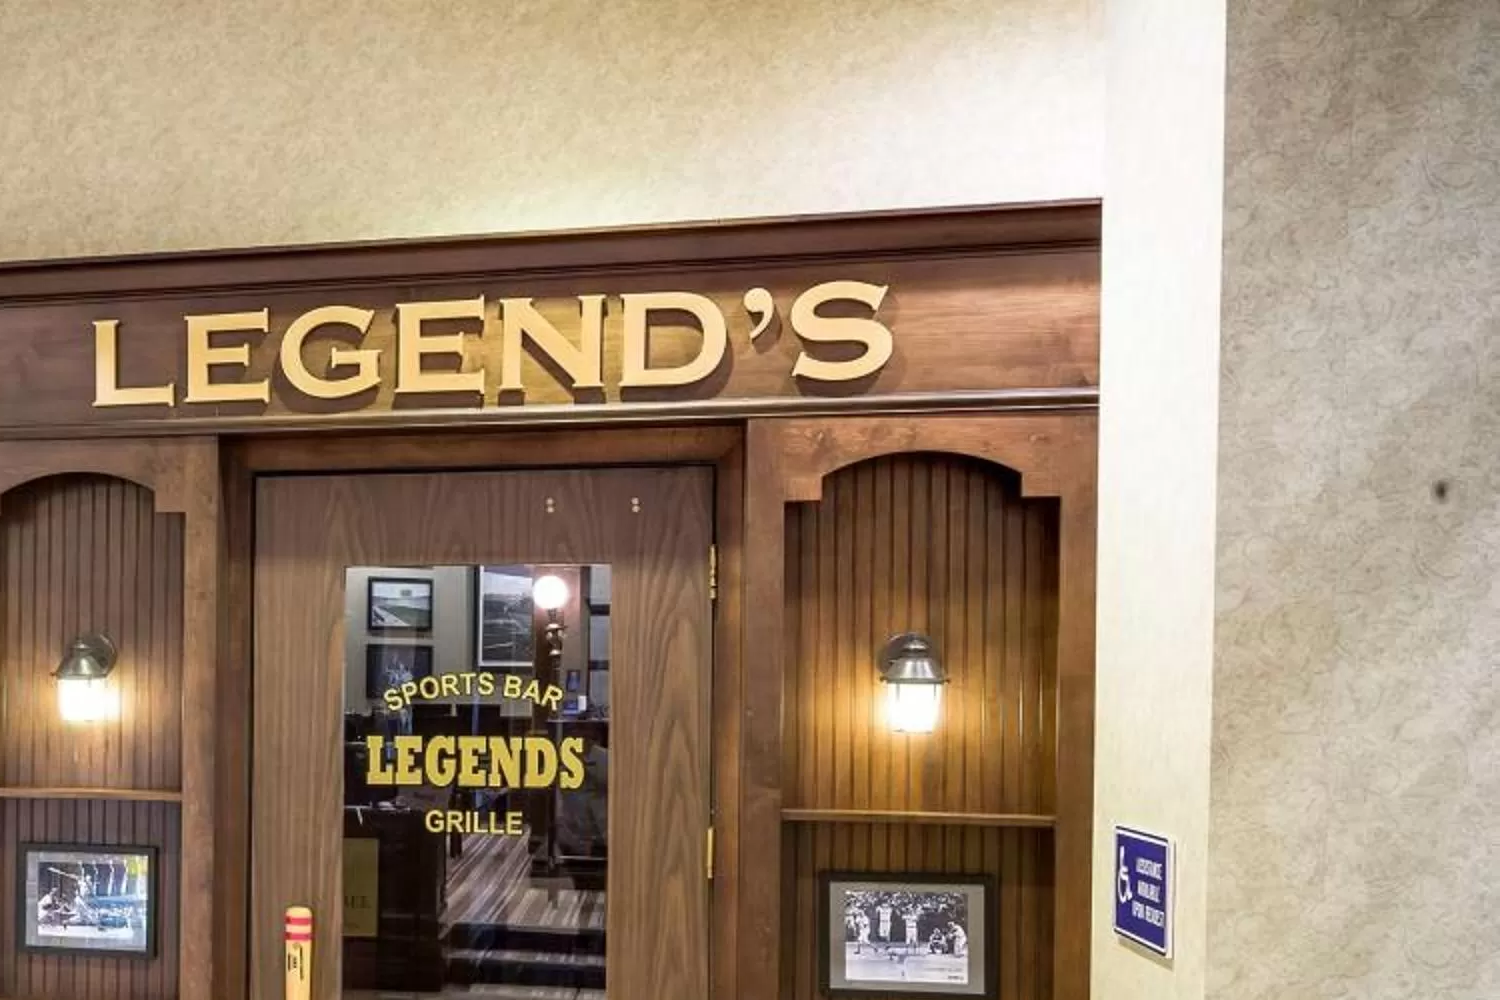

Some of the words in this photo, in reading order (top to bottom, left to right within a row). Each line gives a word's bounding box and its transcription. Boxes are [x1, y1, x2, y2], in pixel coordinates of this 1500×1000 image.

[92, 280, 894, 407] LEGEND'S
[383, 671, 495, 712] SPORTS
[503, 675, 564, 711] BAR
[366, 735, 586, 789] LEGENDS
[425, 809, 524, 835] GRILLE
